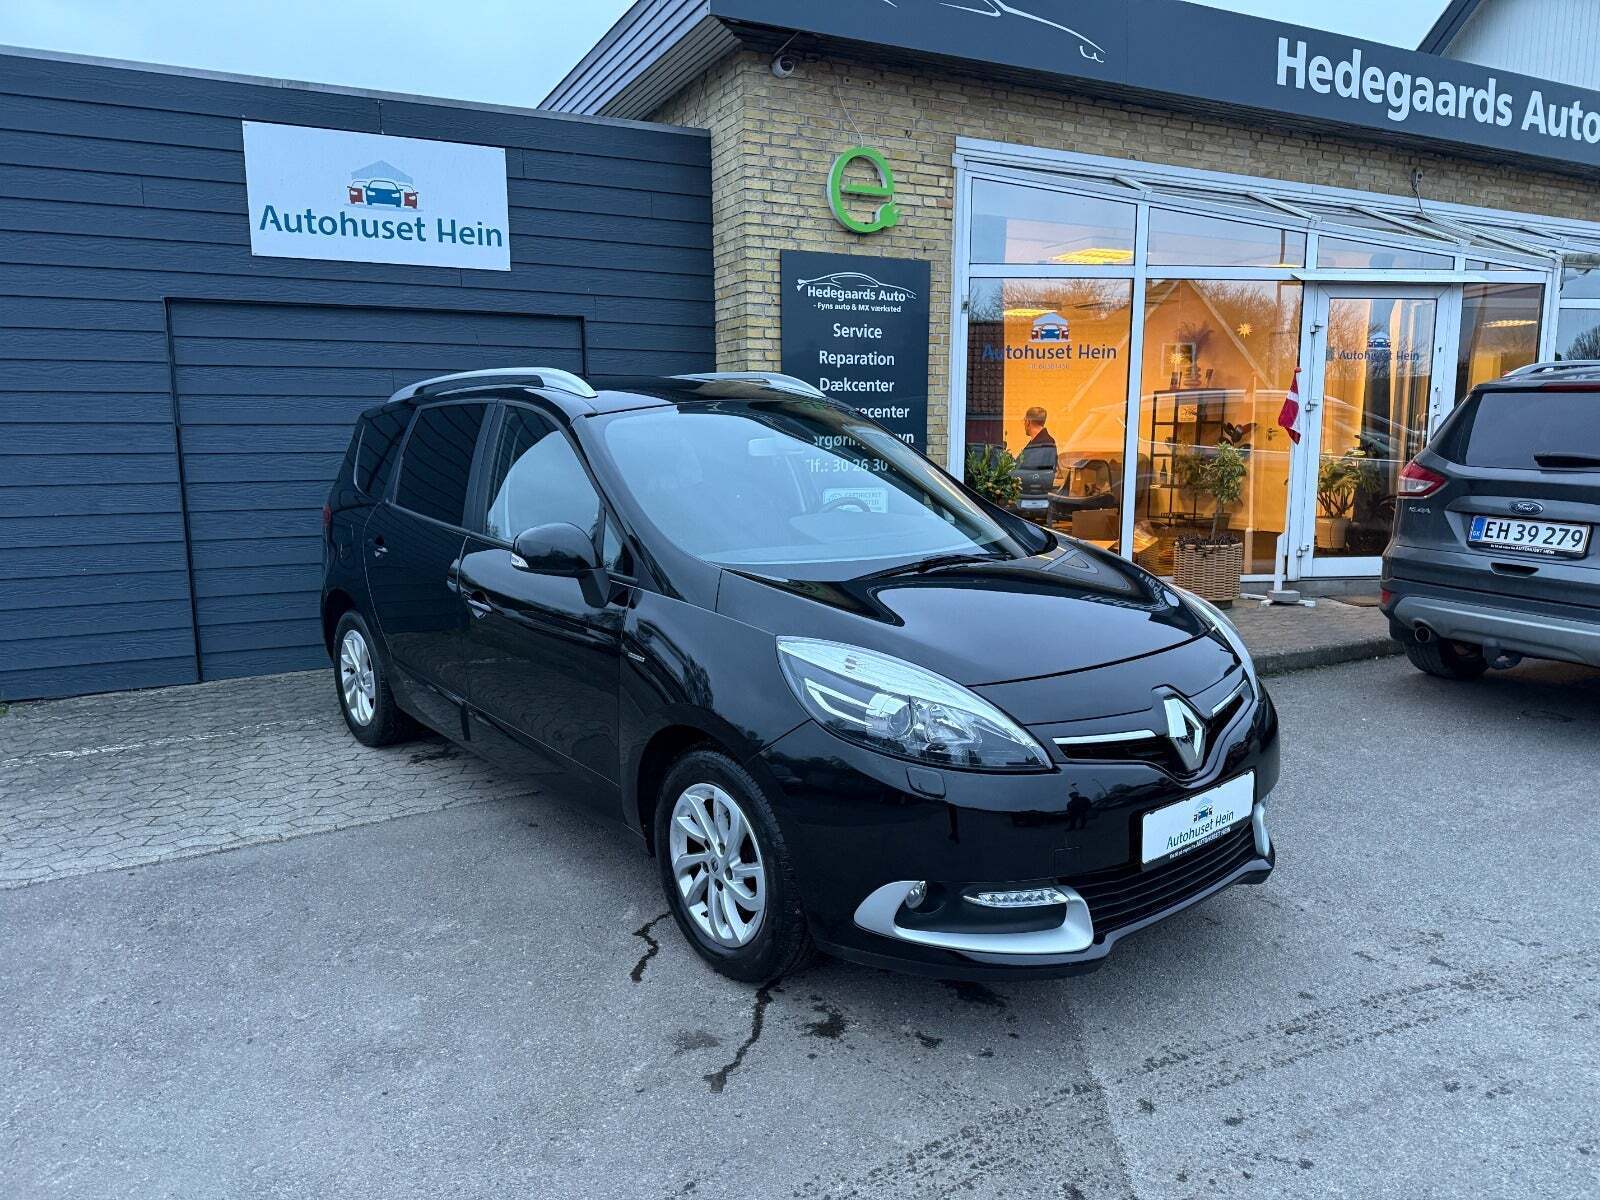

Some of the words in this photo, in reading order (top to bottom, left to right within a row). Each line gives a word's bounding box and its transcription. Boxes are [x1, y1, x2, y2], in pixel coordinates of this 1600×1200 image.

[1276, 36, 1513, 127] Hedegaards
[1521, 89, 1600, 145] Auto
[259, 204, 427, 242] Autohuset
[437, 217, 503, 247] Hein
[807, 285, 876, 301] Hedegaards
[879, 290, 906, 301] Auto
[817, 302, 834, 311] Fyns
[834, 303, 851, 311] auto
[870, 305, 902, 313] værksted
[833, 323, 883, 339] Service
[819, 350, 895, 369] Reparation
[981, 343, 1073, 360] Autohuset
[1078, 343, 1117, 360] Hein
[1396, 350, 1420, 361] Hein
[819, 377, 895, 392] Dækcenter
[1484, 521, 1511, 540] EH
[1513, 523, 1540, 543] 39
[1542, 526, 1584, 548] 279
[1166, 818, 1214, 850] Autohuset
[1215, 810, 1234, 826] Hein
